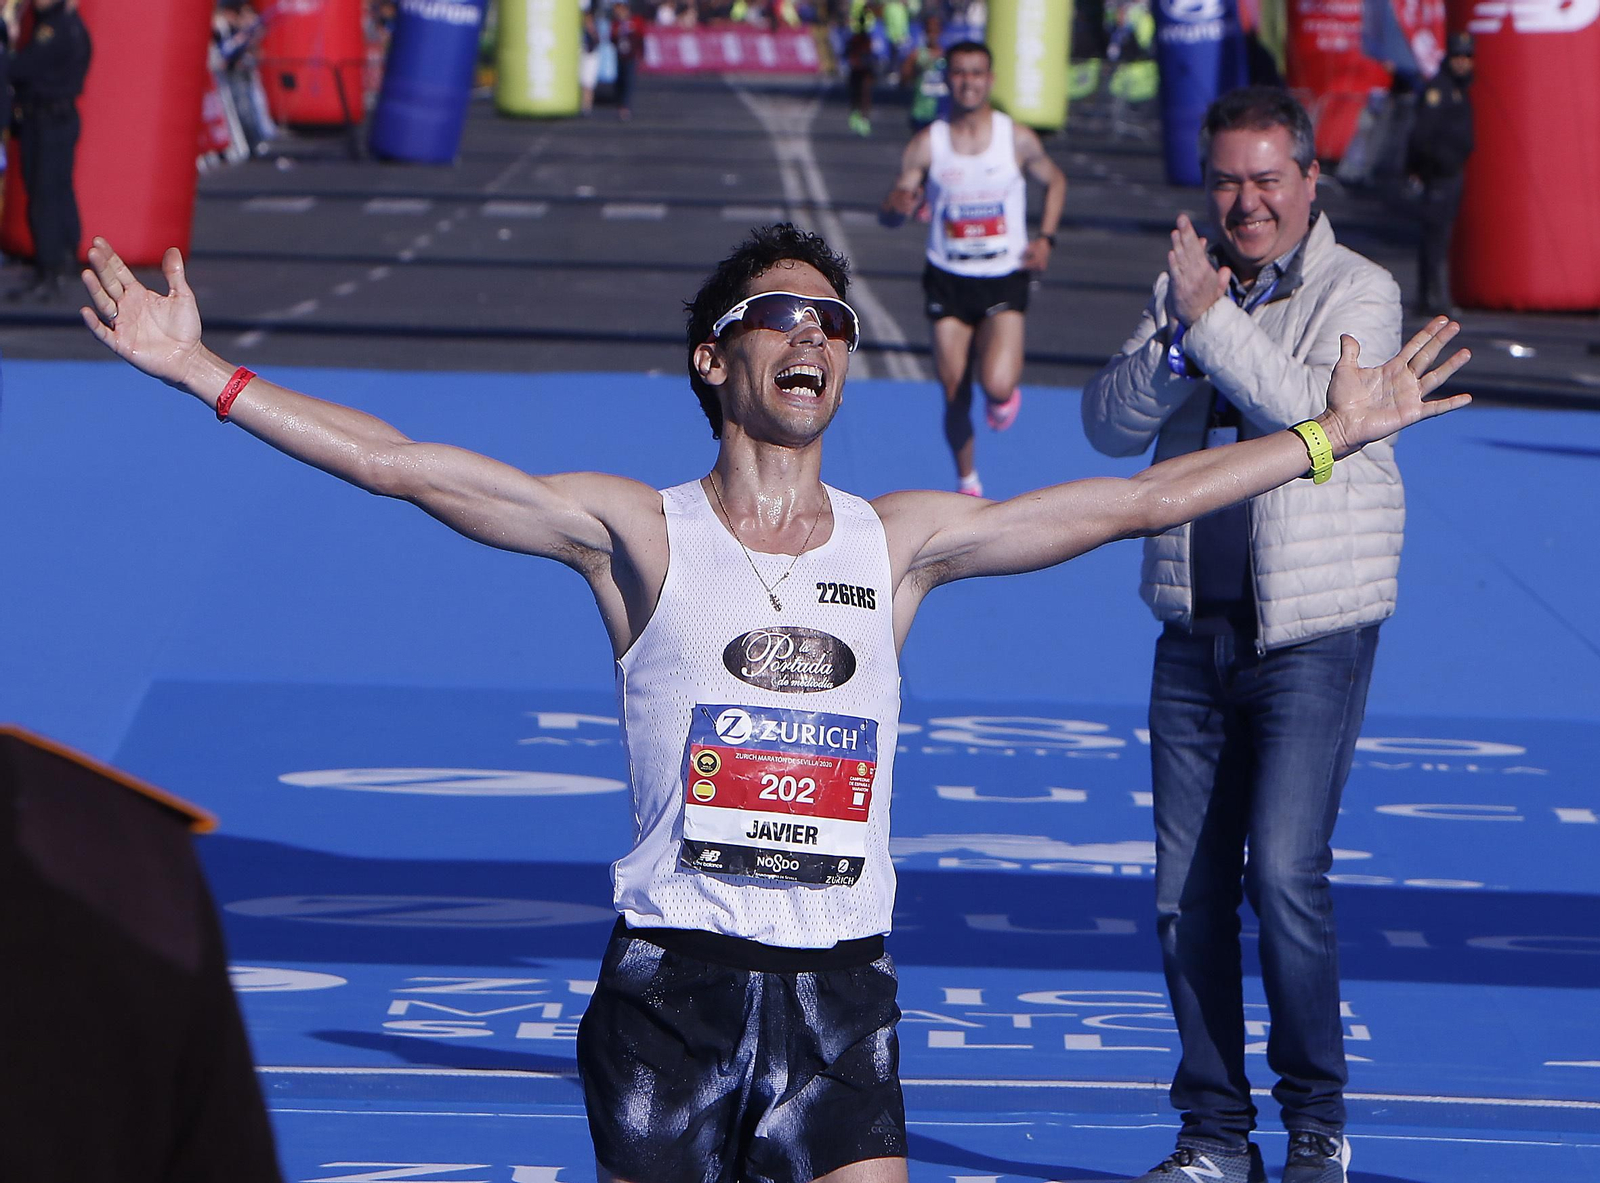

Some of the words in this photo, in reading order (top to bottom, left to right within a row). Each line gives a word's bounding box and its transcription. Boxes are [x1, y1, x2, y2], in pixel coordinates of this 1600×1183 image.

[816, 582, 877, 610] 226ERS
[741, 630, 833, 677] Portada
[759, 720, 858, 751] ZURICH
[735, 752, 758, 761] ZURICH
[796, 758, 818, 767] SEVILLA
[759, 774, 816, 804] 202
[746, 820, 819, 845] JAVIER
[825, 875, 855, 885] ZURICH
